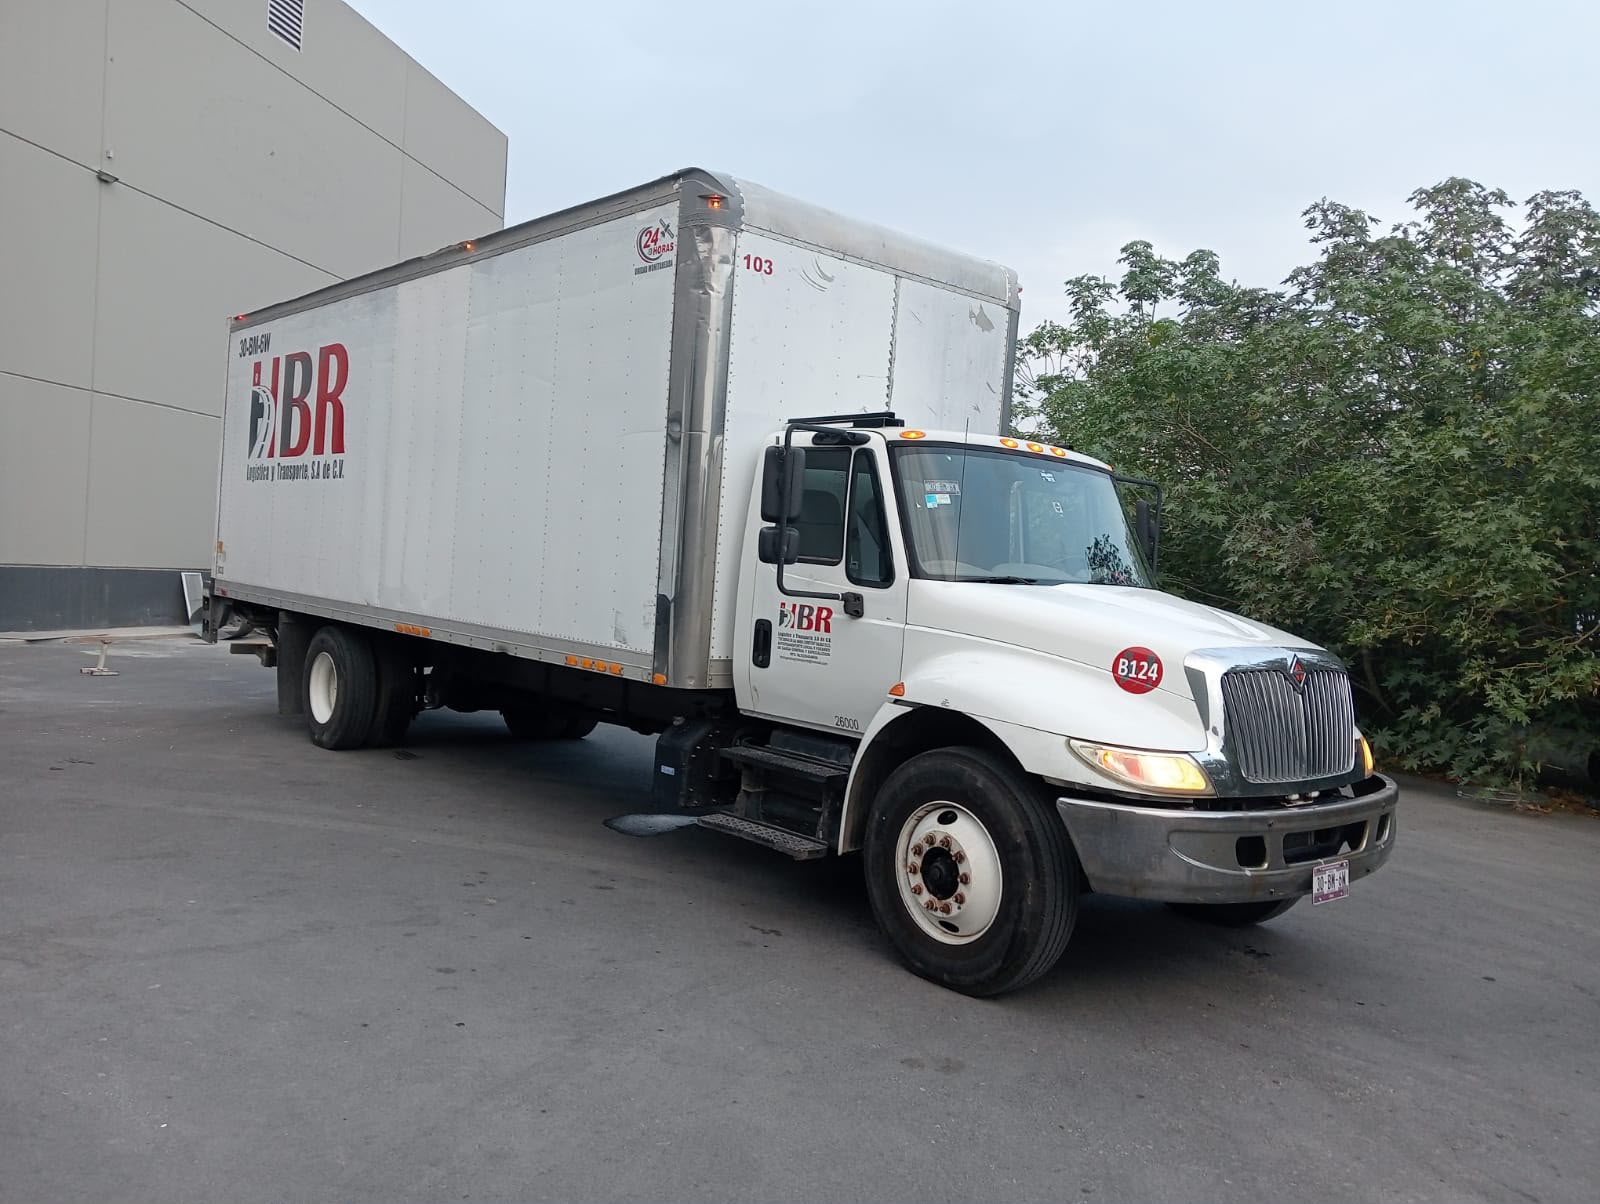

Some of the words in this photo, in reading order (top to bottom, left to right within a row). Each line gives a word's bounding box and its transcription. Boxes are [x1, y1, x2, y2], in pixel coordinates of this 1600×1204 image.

[643, 227, 660, 249] 24
[653, 242, 674, 256] HORAS
[743, 253, 773, 275] 103
[248, 342, 349, 460] HBR
[271, 464, 275, 482] y
[322, 459, 330, 479] de
[779, 601, 833, 634] HBR
[1117, 657, 1159, 681] B124
[834, 715, 859, 730] 26000
